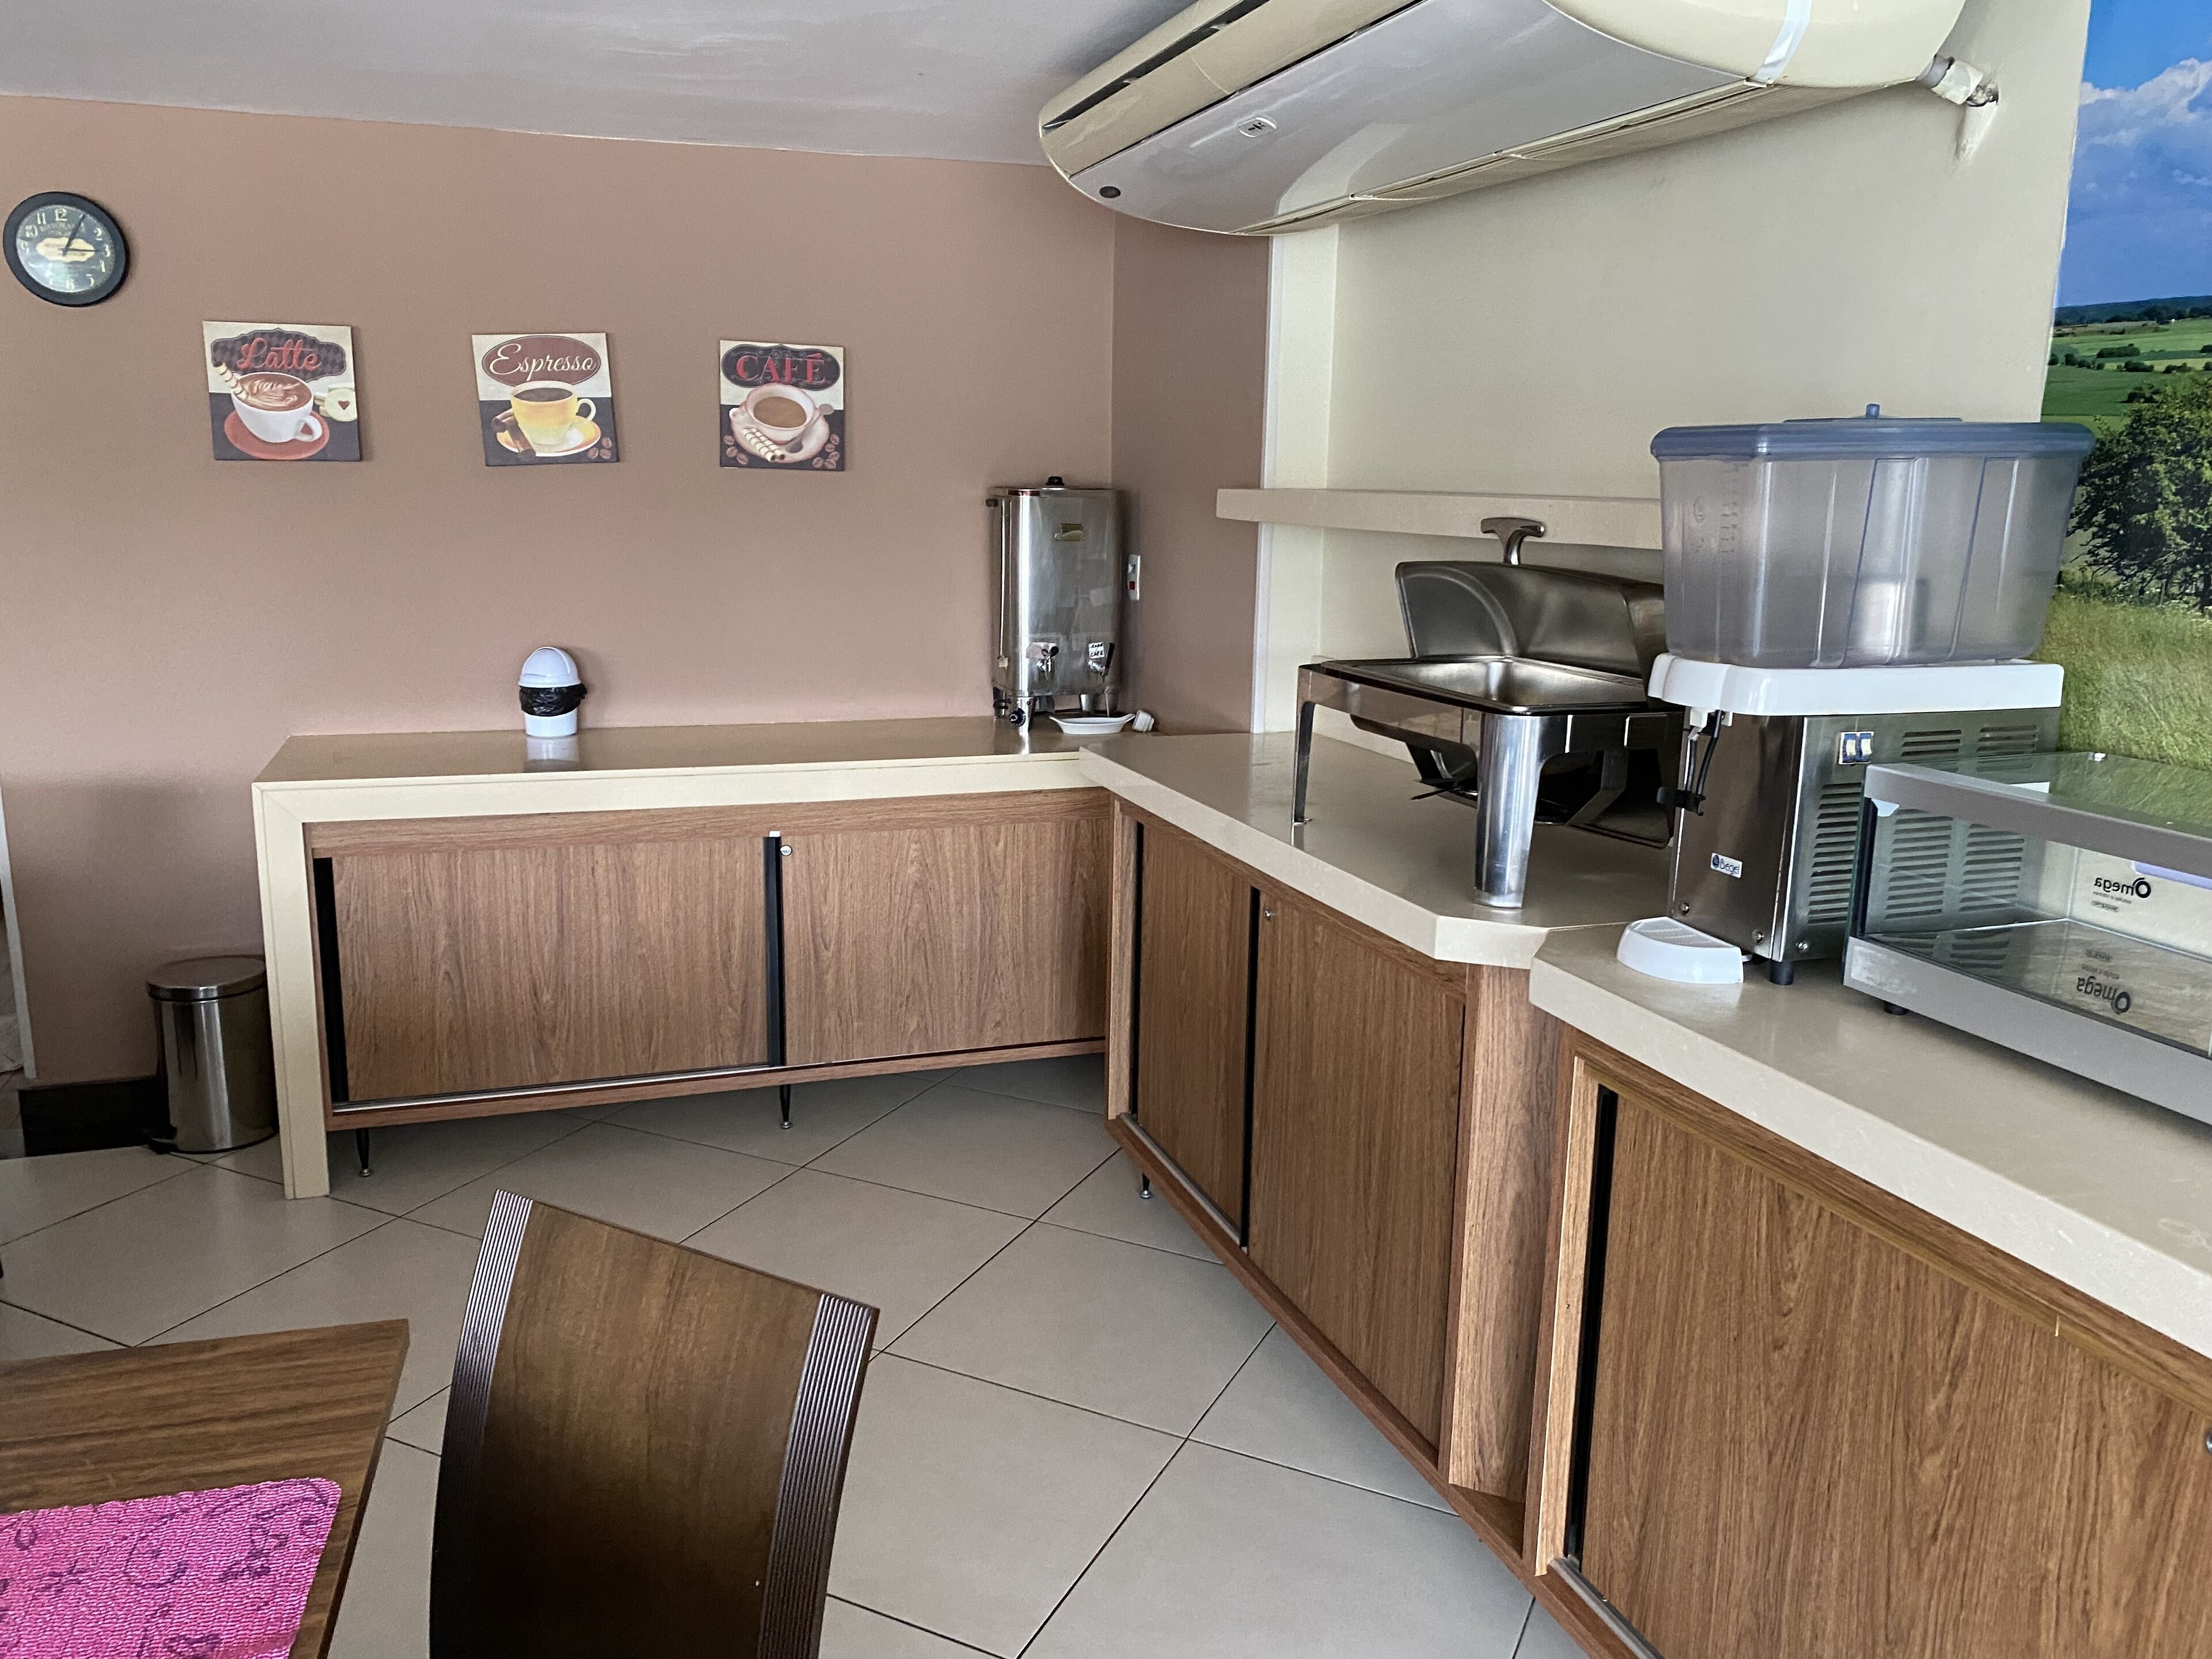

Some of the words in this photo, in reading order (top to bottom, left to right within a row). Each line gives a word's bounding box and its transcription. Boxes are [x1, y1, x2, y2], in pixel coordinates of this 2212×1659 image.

[37, 213, 47, 224] 11
[237, 338, 322, 371] Latte
[490, 343, 597, 381] Espresso
[736, 353, 826, 384] CAFÉ
